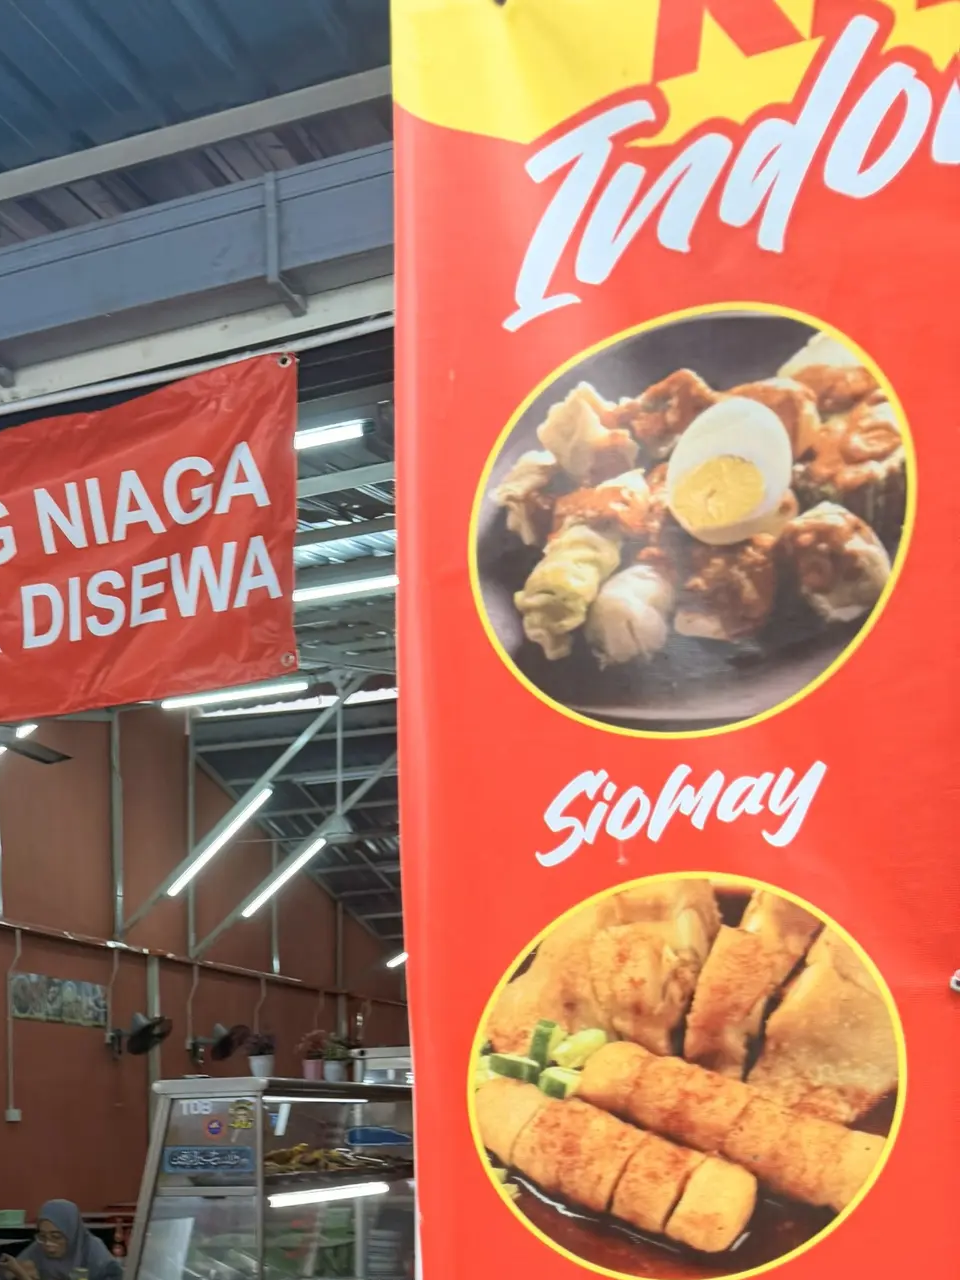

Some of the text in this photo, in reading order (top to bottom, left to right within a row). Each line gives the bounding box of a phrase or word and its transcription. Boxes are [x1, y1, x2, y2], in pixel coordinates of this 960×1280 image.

[501, 14, 960, 333] Indo
[33, 441, 271, 555] NIAGA
[20, 534, 284, 650] DISEWA
